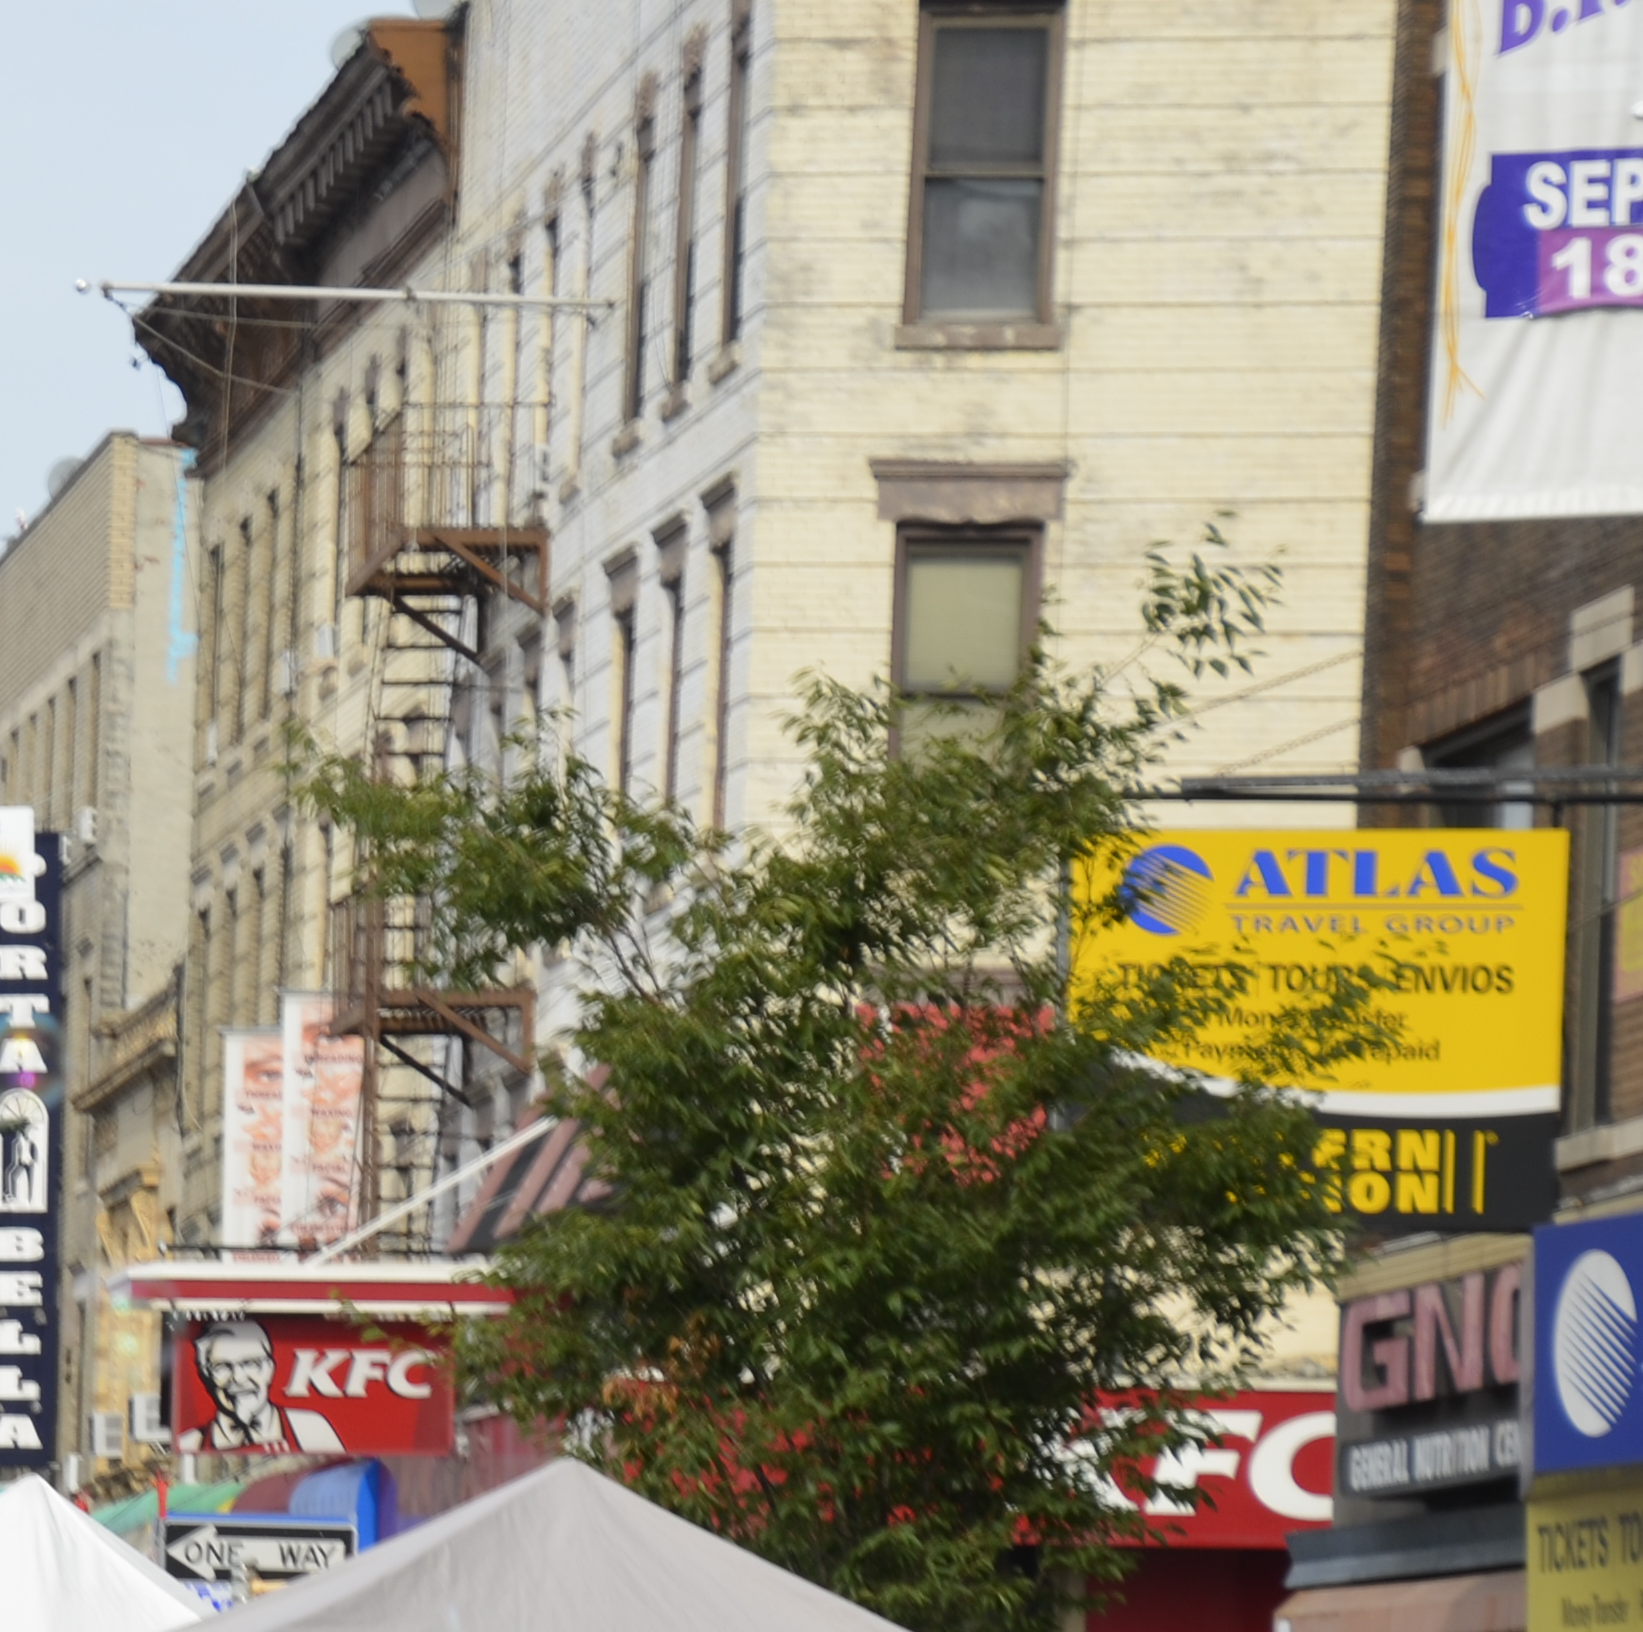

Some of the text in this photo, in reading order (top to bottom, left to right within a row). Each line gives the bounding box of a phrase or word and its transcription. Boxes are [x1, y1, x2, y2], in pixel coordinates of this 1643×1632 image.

[1551, 233, 1643, 300] 18
[1234, 848, 1520, 898] ATLAS
[1231, 913, 1515, 935] TRAVEL GROUP
[1268, 964, 1367, 994] TOUR
[1396, 963, 1515, 994] ENVIOS
[284, 1347, 438, 1399] KFC
[1350, 1438, 1410, 1492] GENERAL
[183, 1540, 337, 1570] ONE WAY
[1536, 1516, 1609, 1576] TICKETS
